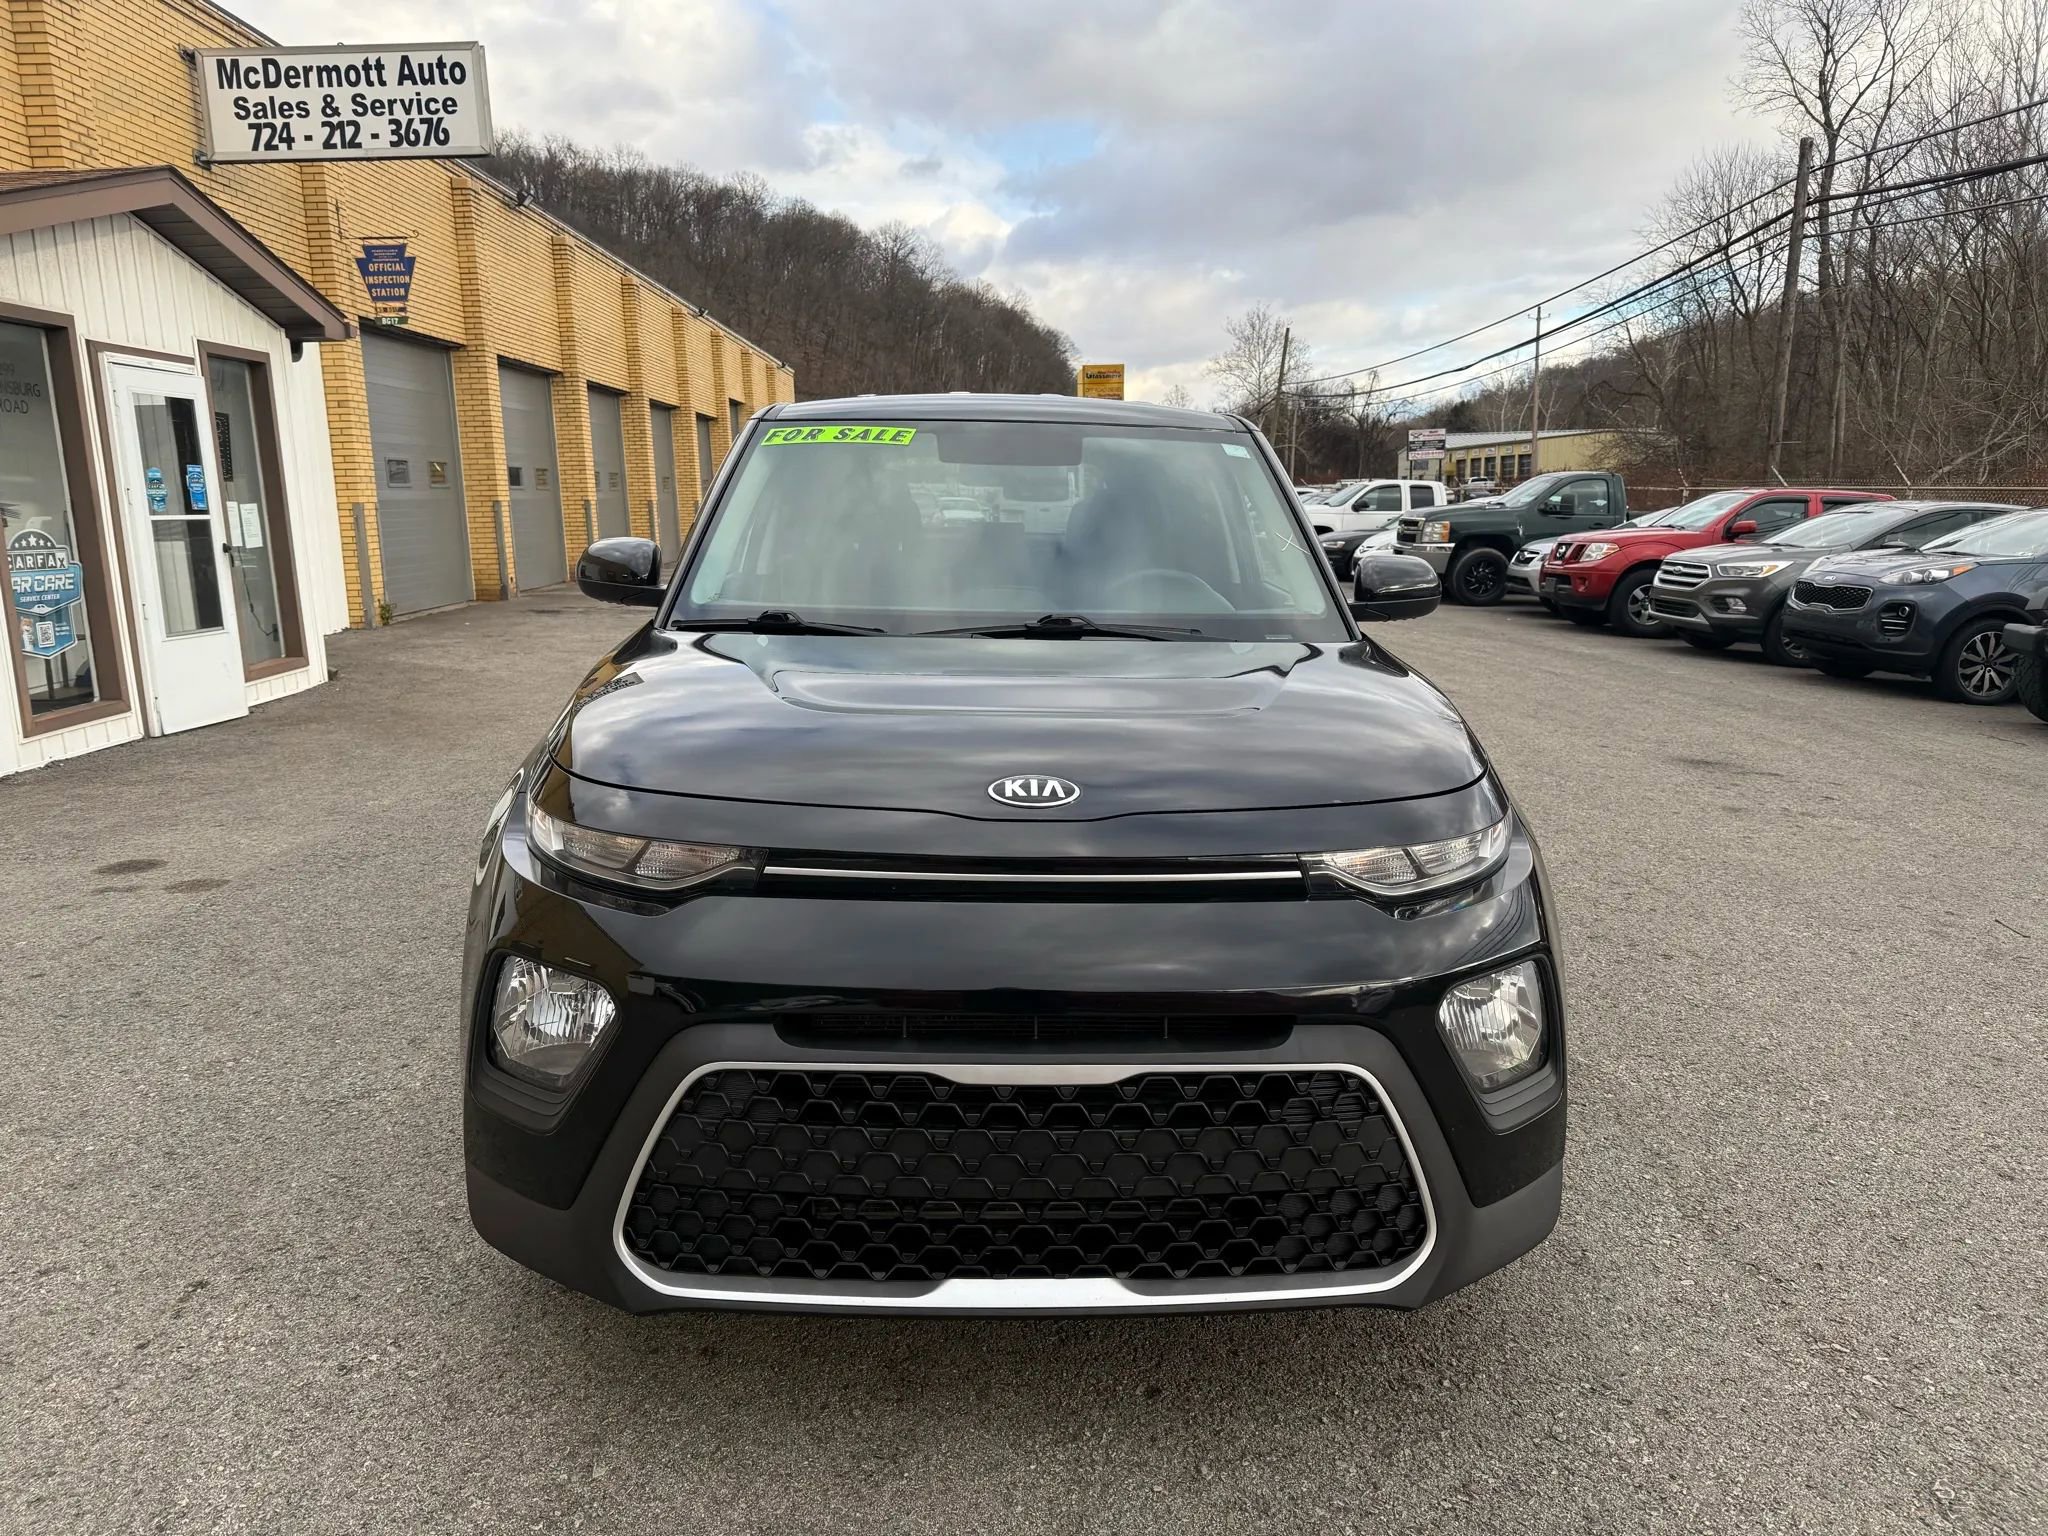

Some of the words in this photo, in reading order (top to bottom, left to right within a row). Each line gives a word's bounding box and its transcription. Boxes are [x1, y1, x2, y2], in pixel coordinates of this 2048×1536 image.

[216, 56, 387, 89] McDermott
[397, 54, 467, 86] Auto
[233, 95, 310, 120] Sales
[320, 93, 341, 118] &
[351, 91, 458, 117] Service
[247, 121, 296, 151] 724
[320, 119, 363, 150] 212
[388, 116, 450, 148] 3676
[368, 263, 406, 272] OFFICIAL
[365, 276, 410, 285] INSPECTION
[371, 288, 405, 297] STATION
[764, 428, 826, 443] FOR
[832, 427, 912, 443] SALE
[7, 554, 66, 569] ARFAX
[34, 573, 75, 592] CARE
[20, 595, 41, 603] SERVICE
[41, 593, 60, 601] CENTER
[1003, 779, 1066, 798] KIA
